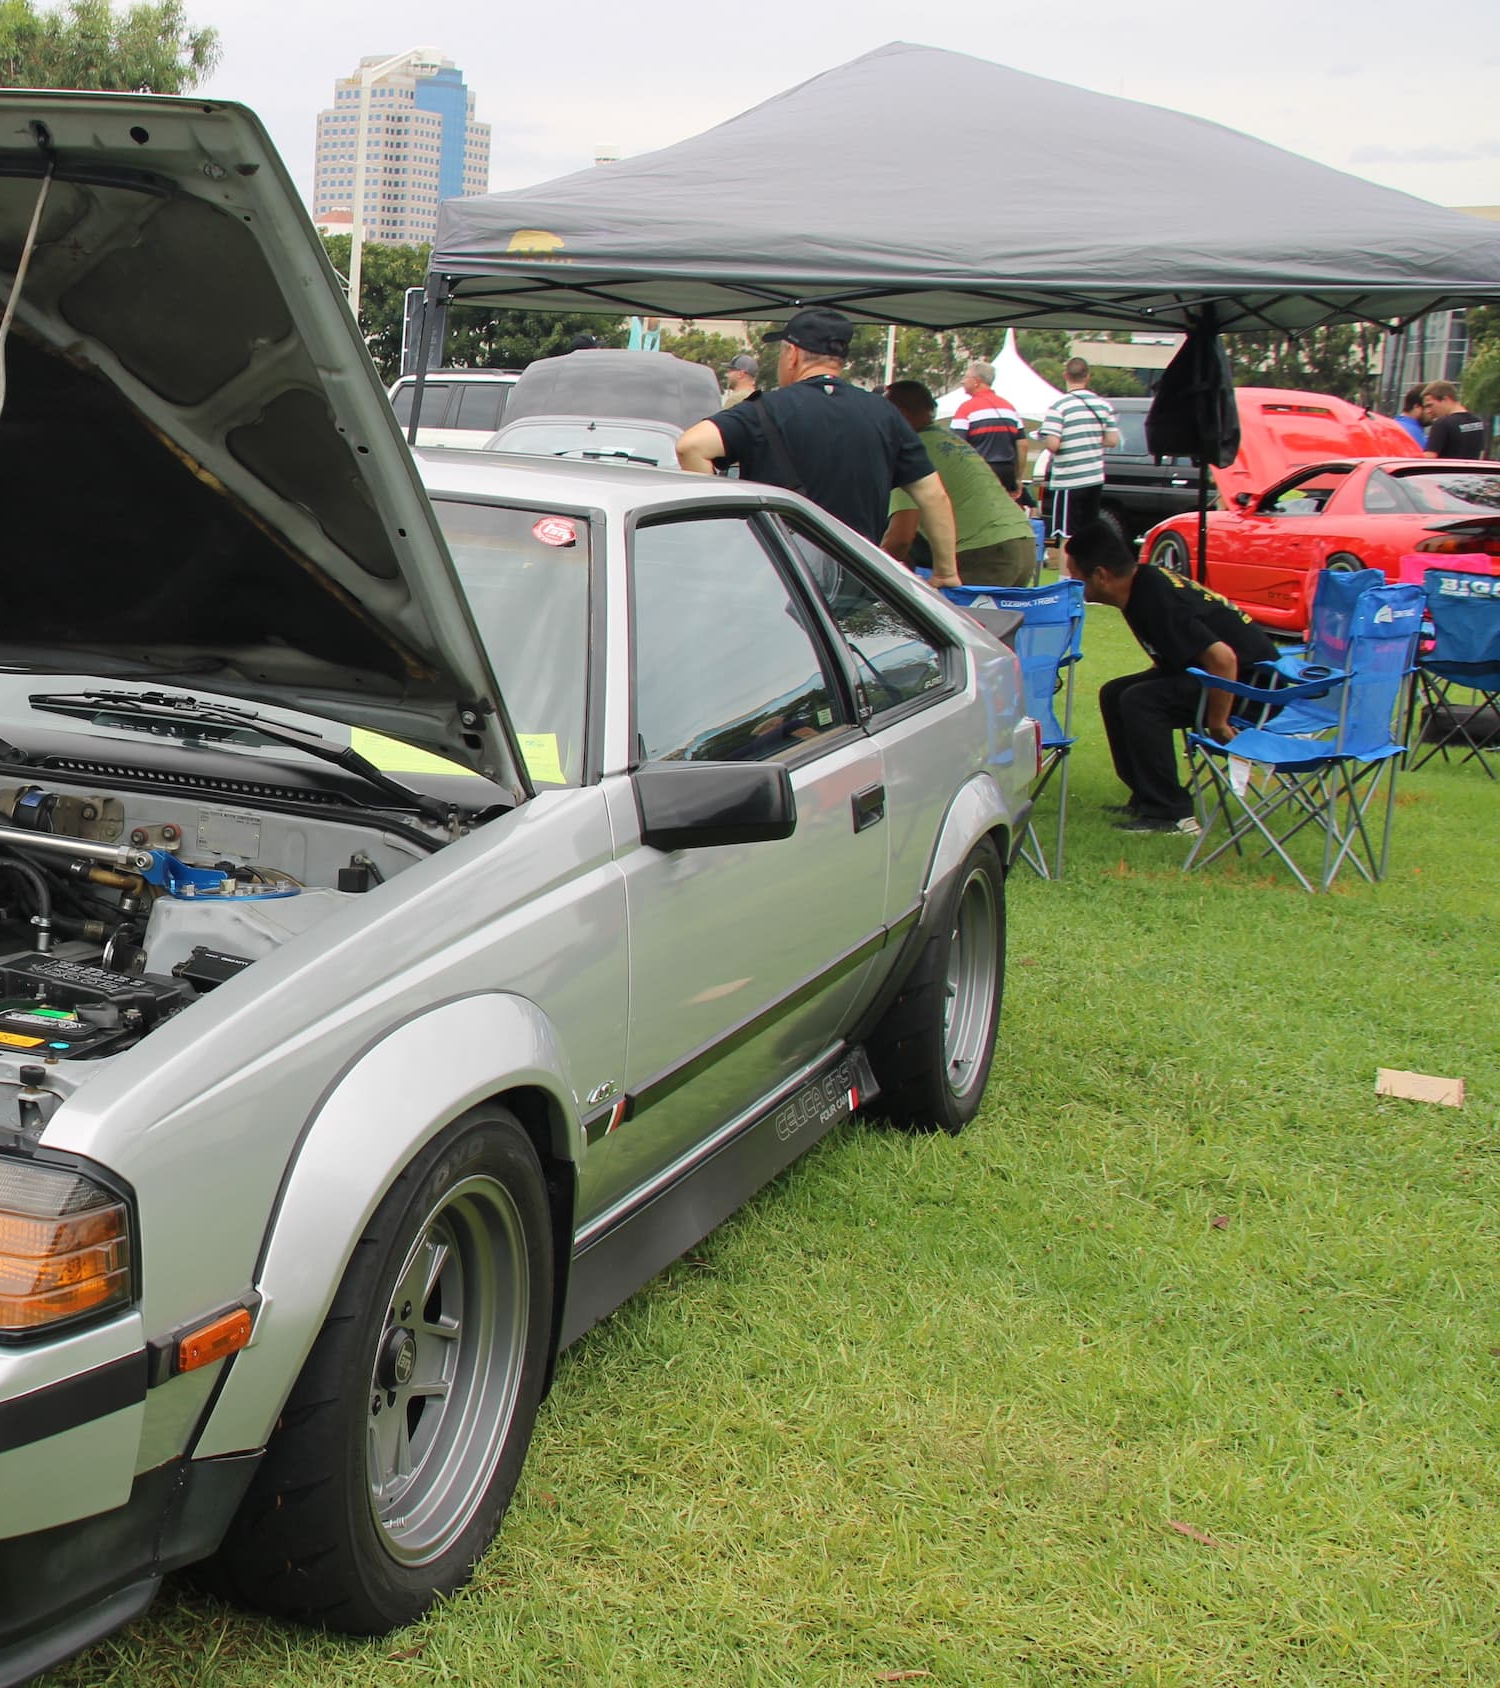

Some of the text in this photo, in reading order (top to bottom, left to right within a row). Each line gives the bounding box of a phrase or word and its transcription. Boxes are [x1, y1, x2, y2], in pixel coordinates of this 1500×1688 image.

[1439, 578, 1500, 595] BIG
[775, 1086, 825, 1141] CELICA
[819, 1093, 848, 1124] FOUR CAM
